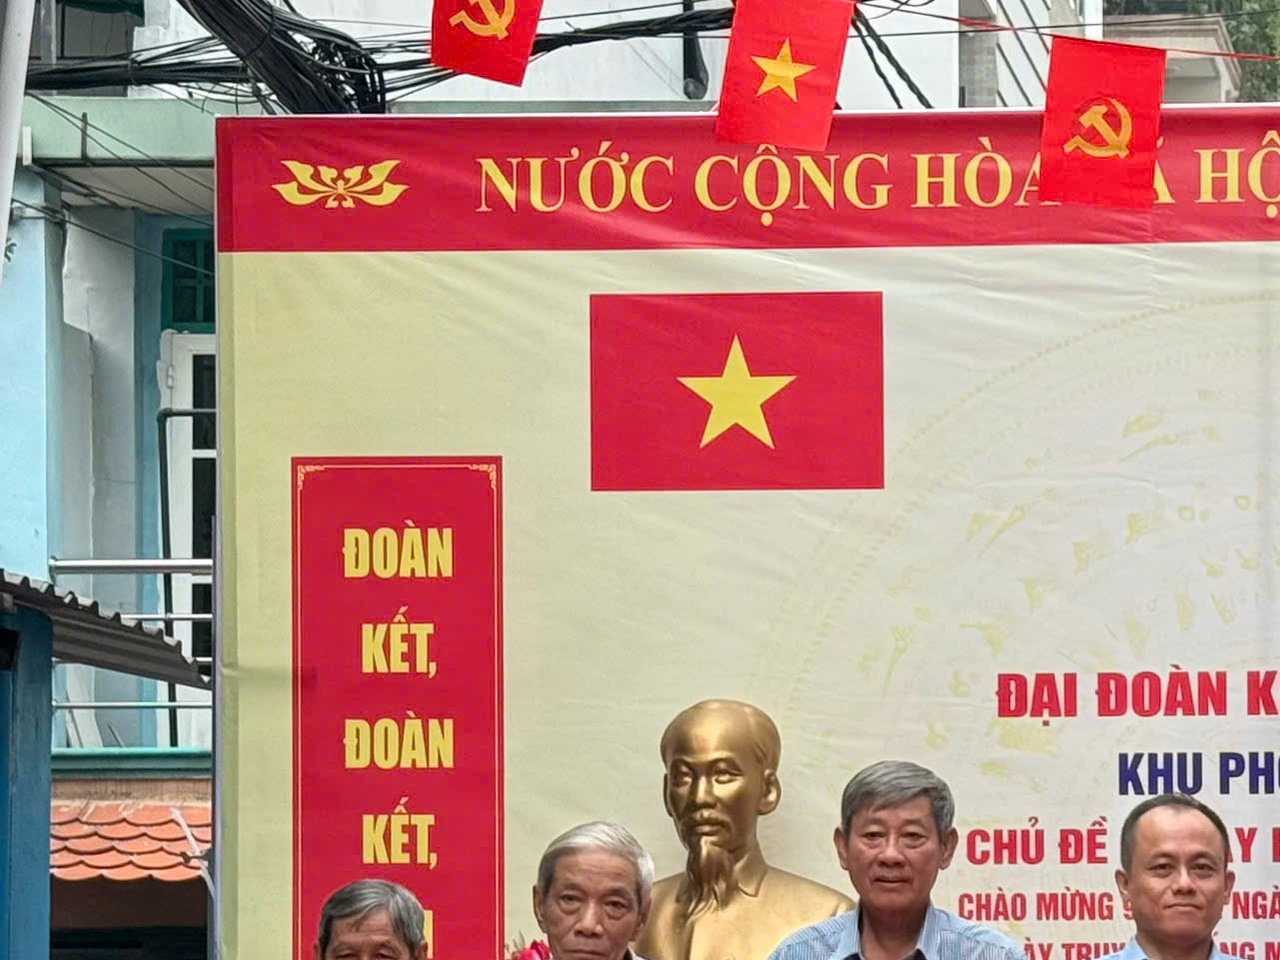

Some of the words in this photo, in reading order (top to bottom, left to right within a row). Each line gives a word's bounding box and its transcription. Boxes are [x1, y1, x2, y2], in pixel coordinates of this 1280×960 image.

[475, 141, 674, 213] NƯỚC
[694, 143, 893, 227] CỘNG
[342, 519, 453, 579] ĐOÀN
[361, 605, 438, 679] KẾT,
[995, 672, 1077, 727] ĐẠI
[1095, 664, 1227, 717] ĐOÀN
[342, 710, 454, 769] ĐOÀN
[1118, 751, 1203, 796] KHU
[362, 797, 438, 870] KẾT,
[966, 816, 1045, 865] CHỦ
[1058, 815, 1108, 864] ĐỀ
[958, 886, 1027, 921] CHÀO
[1036, 886, 1114, 921] MỪNG
